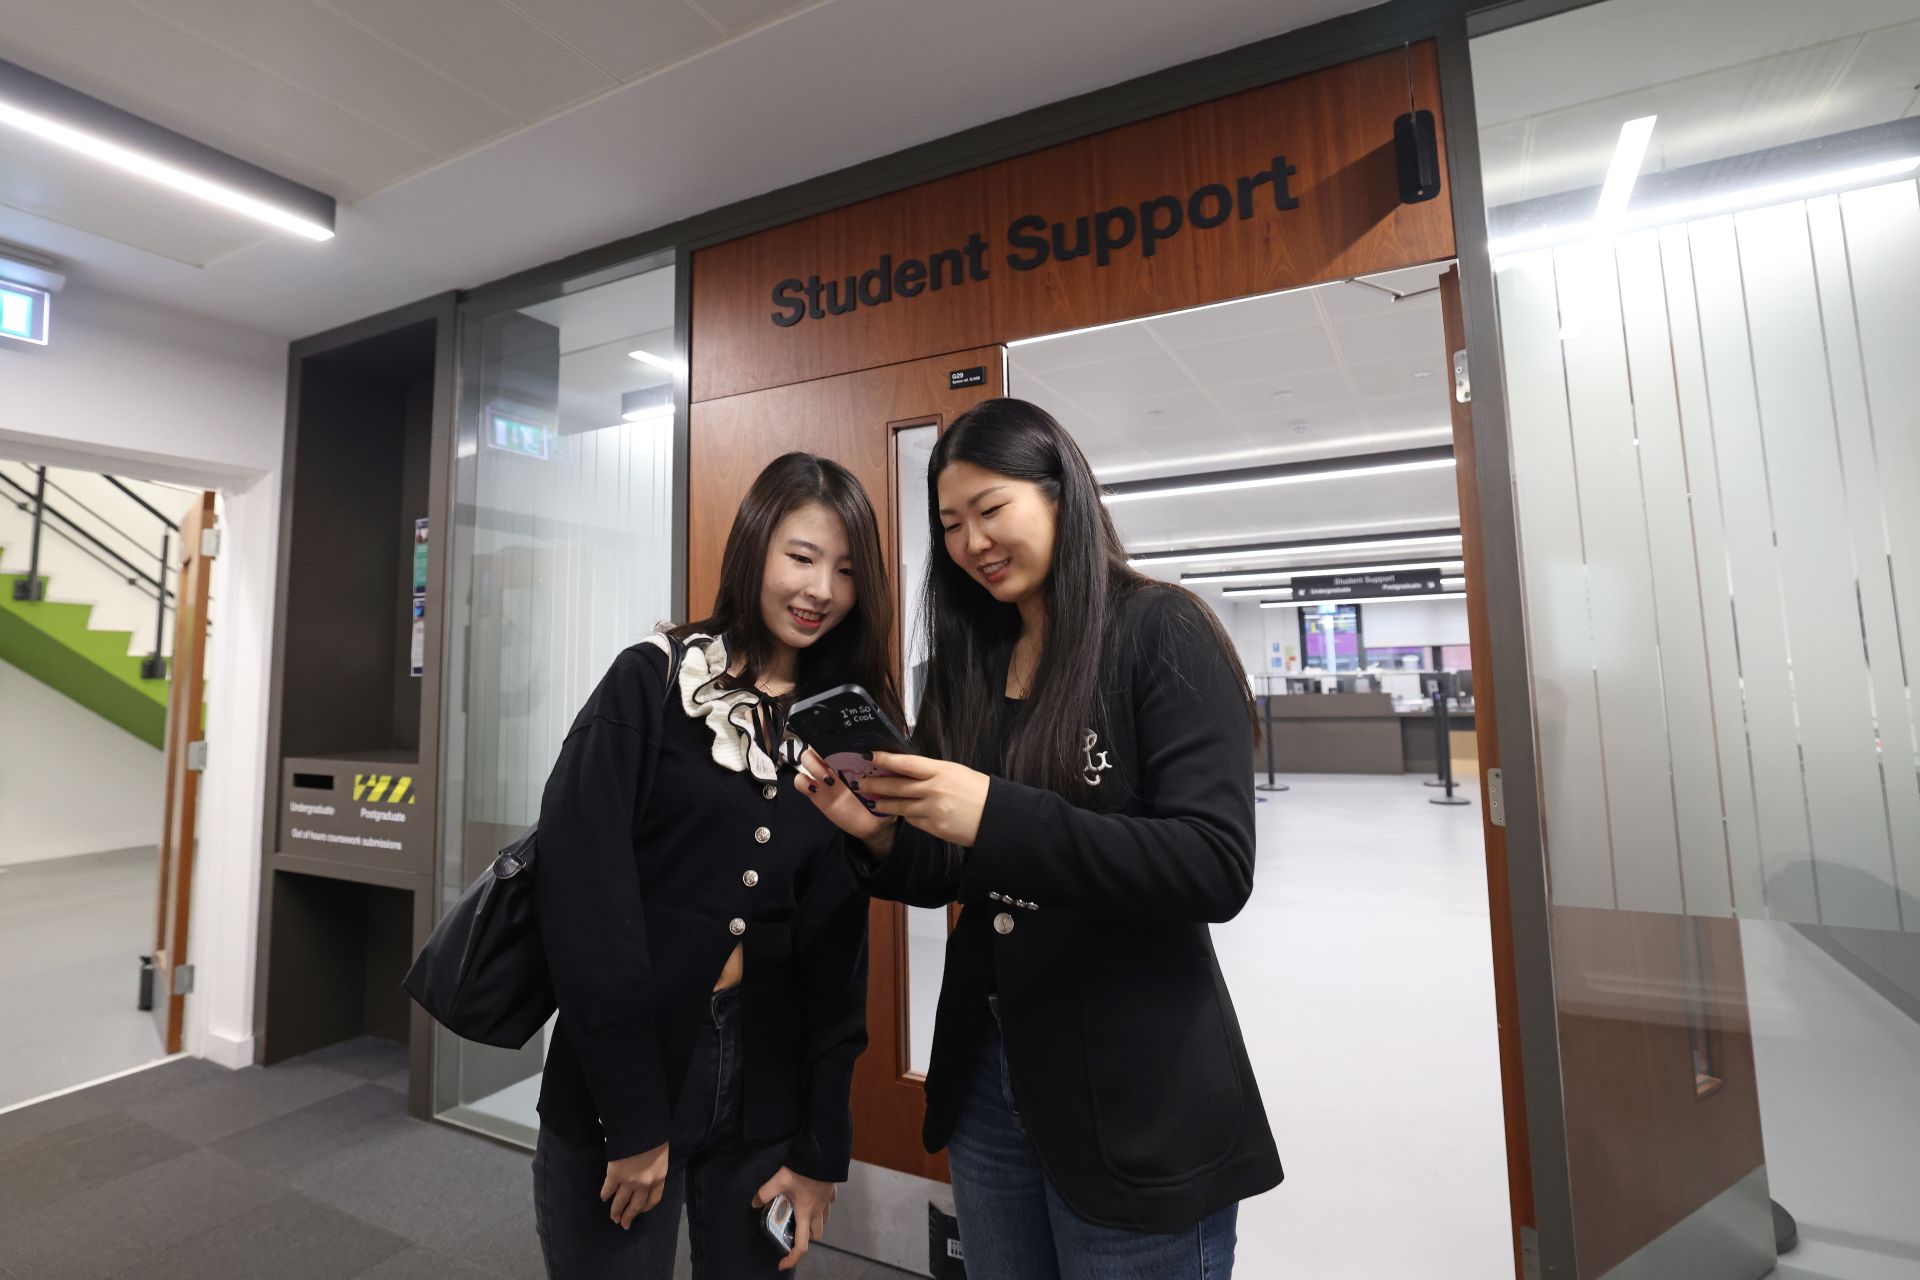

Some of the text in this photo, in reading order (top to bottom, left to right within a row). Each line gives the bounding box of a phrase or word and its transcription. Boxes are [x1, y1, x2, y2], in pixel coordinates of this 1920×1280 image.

[771, 156, 1299, 327] Student Support
[1334, 574, 1395, 586] Student Support
[1310, 587, 1352, 595] Undergraduate
[1382, 582, 1422, 591] Postgraduate
[290, 802, 335, 815] Undergraduate
[360, 807, 406, 822] Postgraduate
